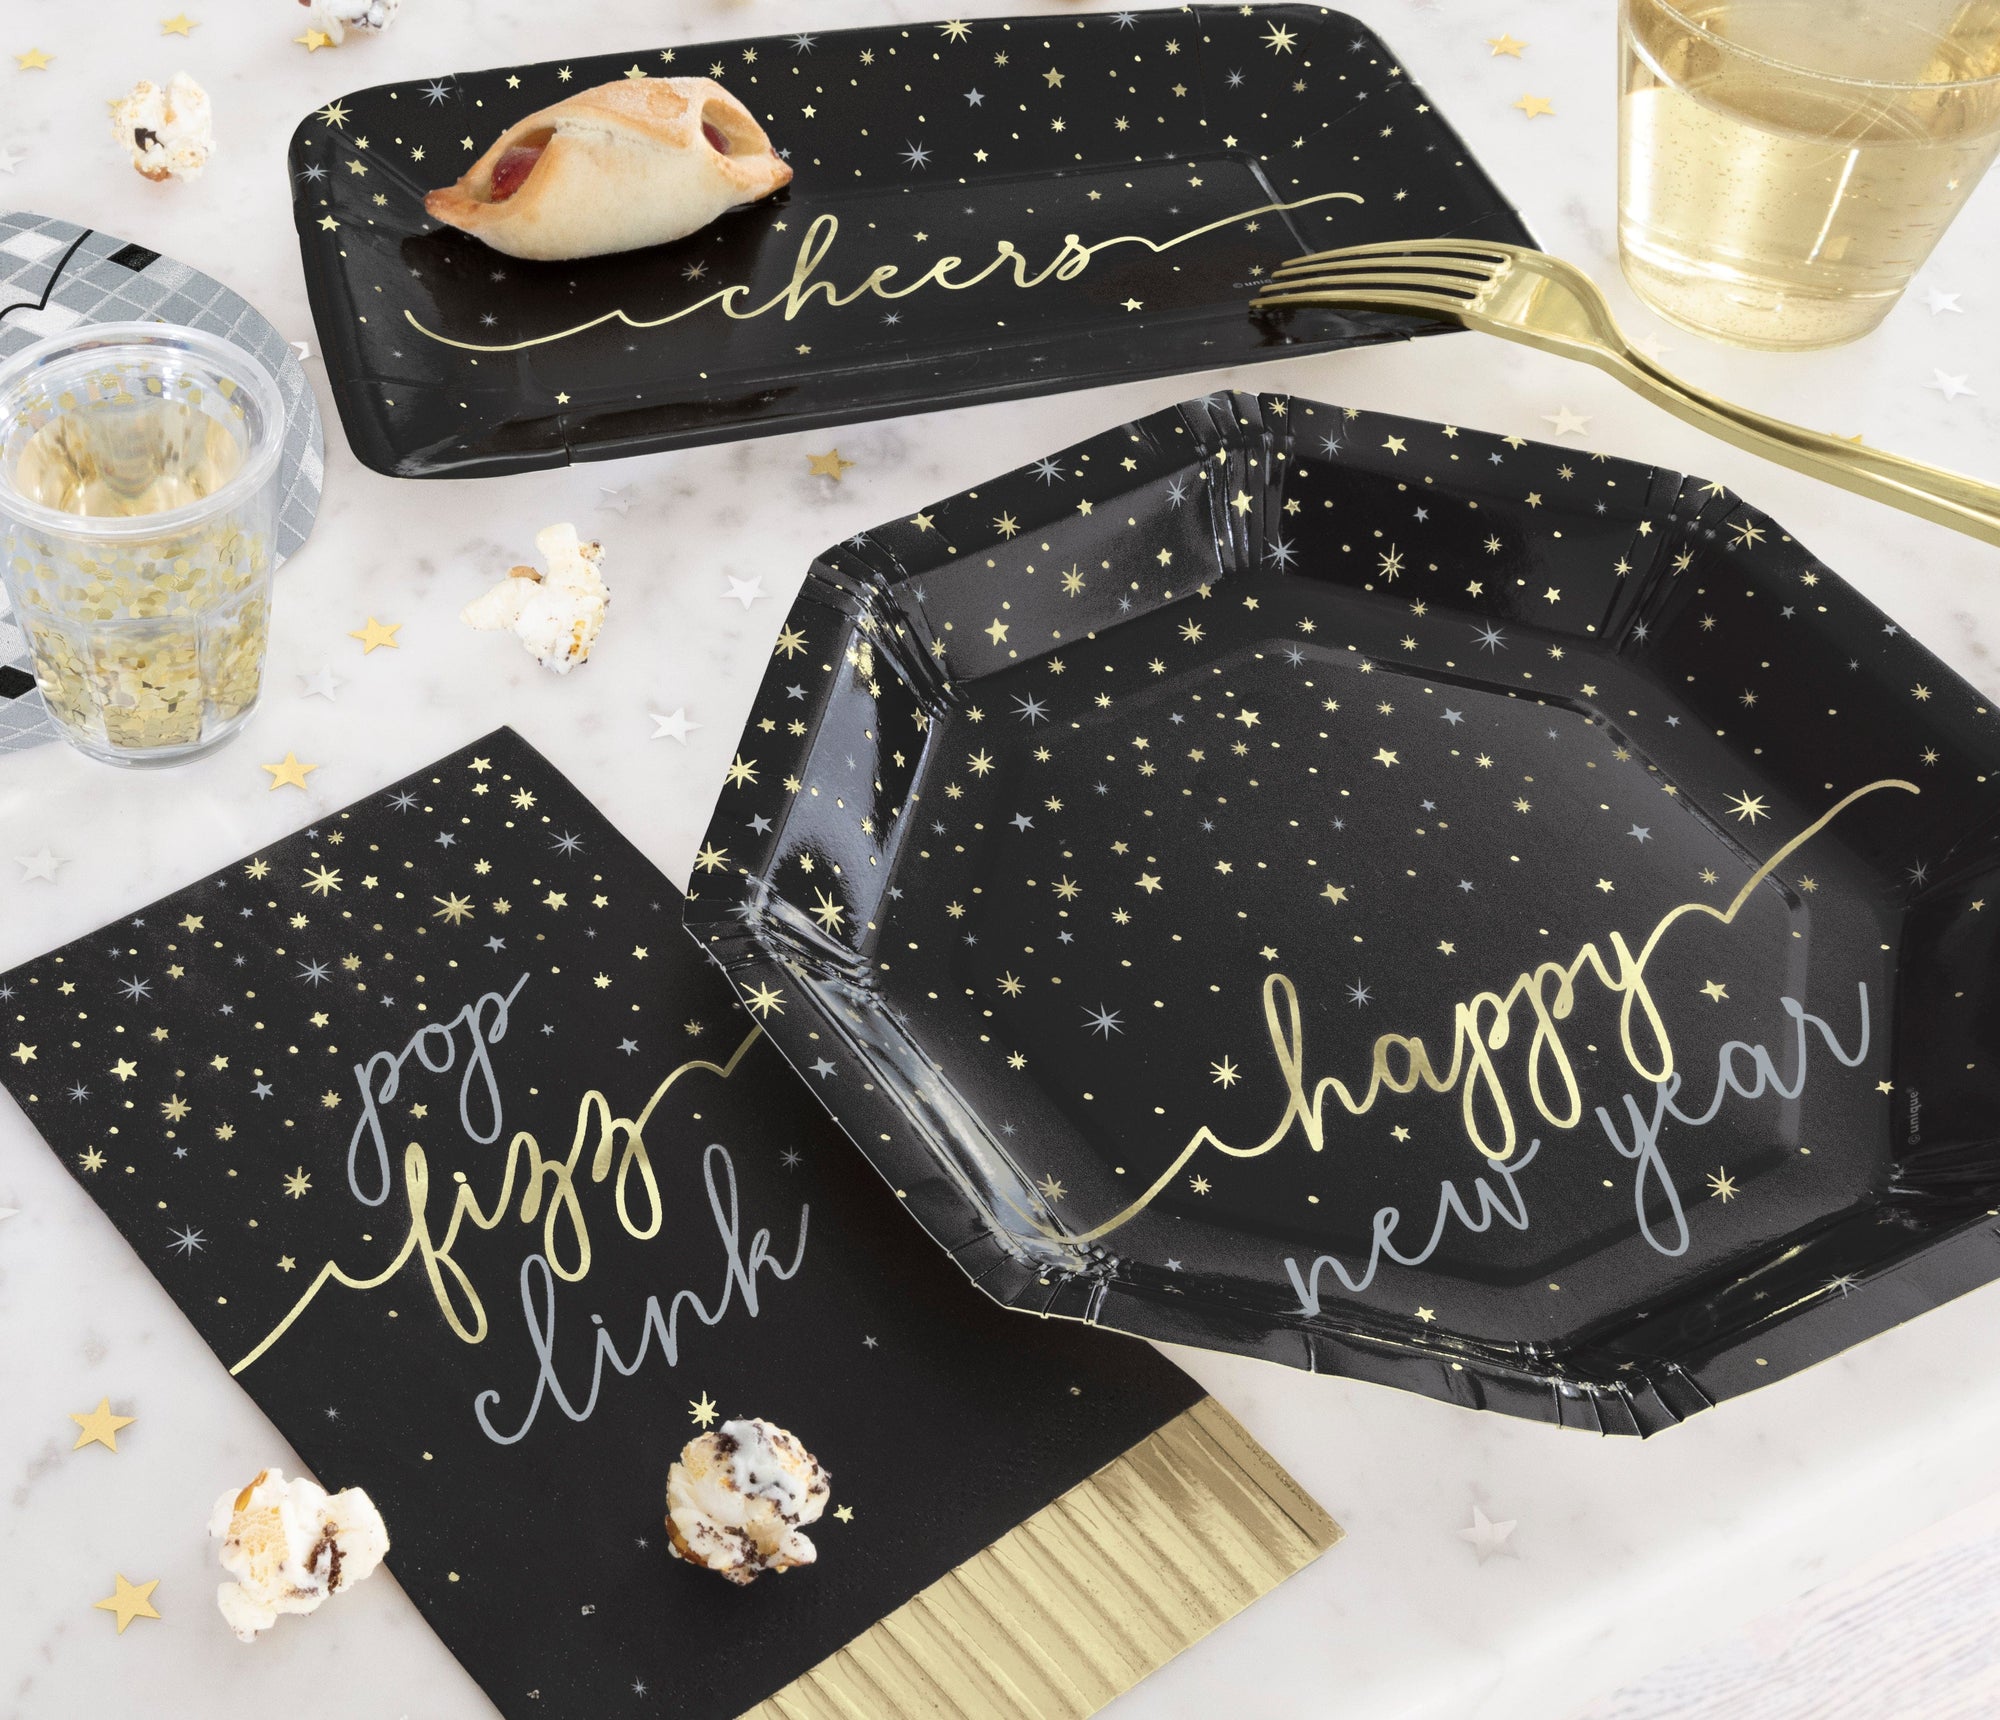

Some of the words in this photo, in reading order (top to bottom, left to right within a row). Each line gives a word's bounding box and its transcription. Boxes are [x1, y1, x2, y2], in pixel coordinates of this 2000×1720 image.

[347, 971, 531, 1207] pop
[1261, 931, 1676, 1161] happy
[1283, 1138, 1541, 1318] new
[1594, 981, 1871, 1257] year
[473, 1143, 810, 1446] clink
